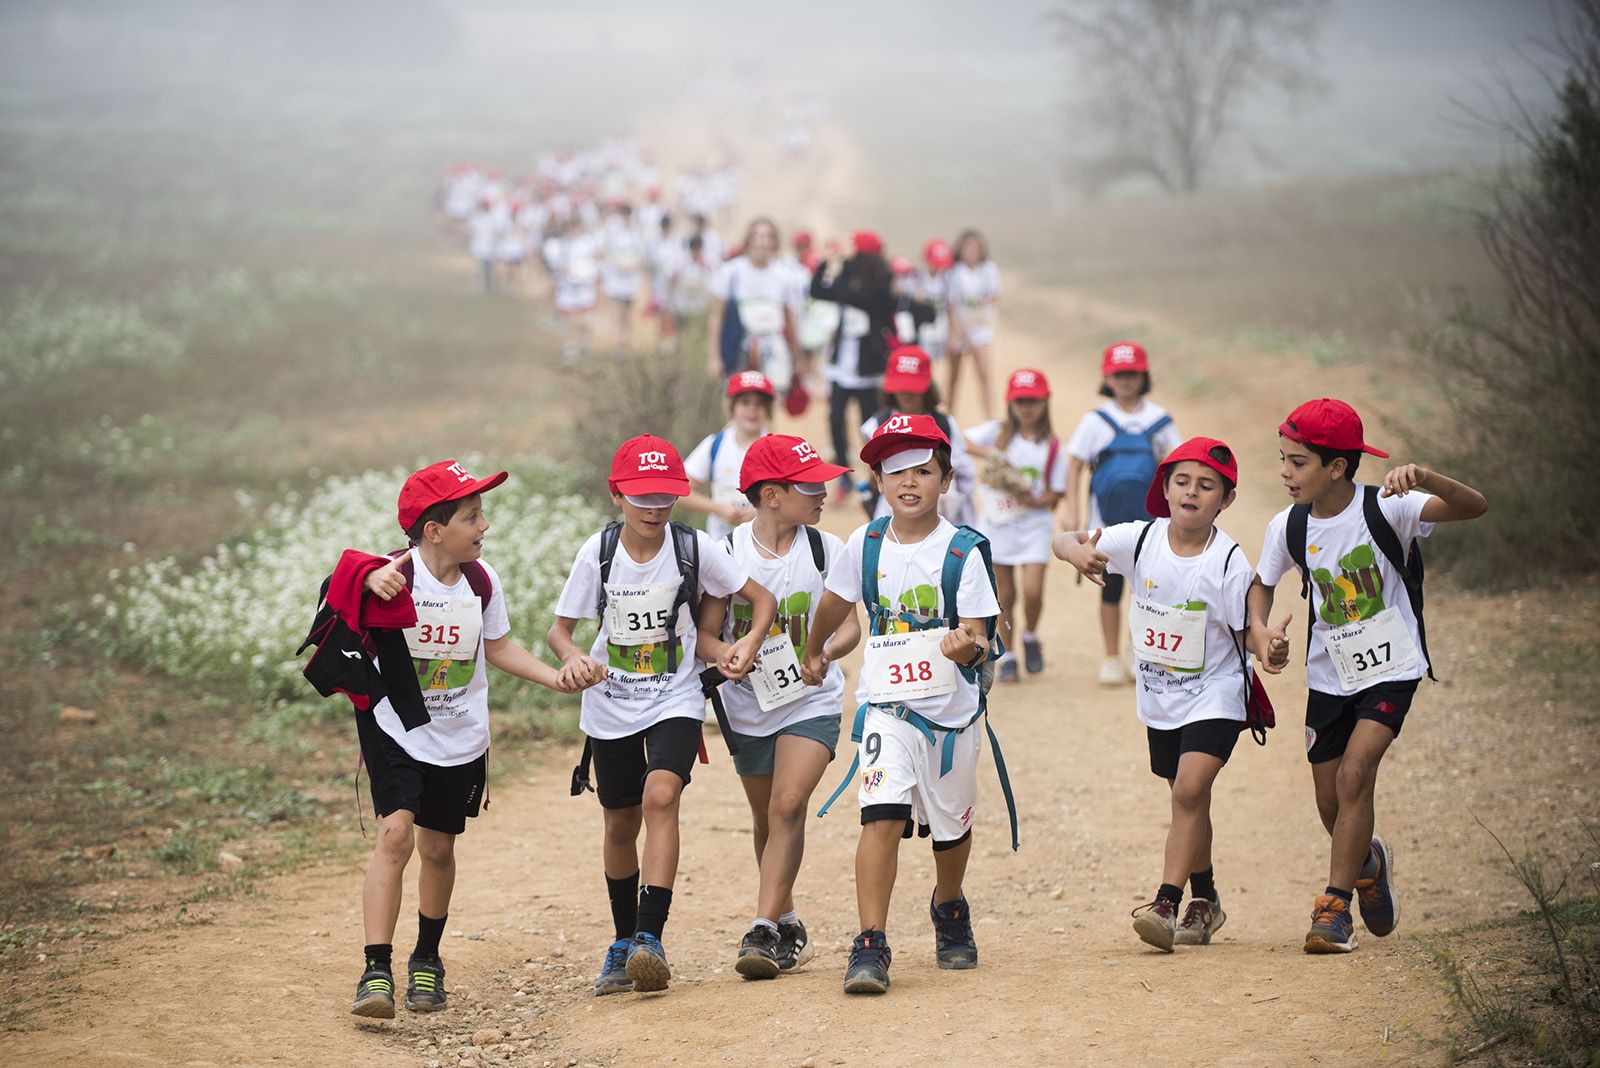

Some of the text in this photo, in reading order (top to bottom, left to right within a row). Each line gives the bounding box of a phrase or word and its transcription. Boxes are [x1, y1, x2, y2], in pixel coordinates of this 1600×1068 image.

[883, 415, 912, 434] TOT
[791, 441, 815, 457] TO
[638, 451, 667, 465] TOT
[446, 461, 466, 477] TO
[622, 589, 650, 597] Marxa"
[421, 600, 449, 608] Marxa"
[1145, 604, 1169, 617] Marxa"
[627, 609, 668, 631] 315
[418, 623, 460, 645] 315
[1144, 627, 1183, 652] 317
[1341, 626, 1366, 639] Marxa"
[882, 637, 911, 648] Marxa"
[1352, 641, 1392, 672] 317
[773, 663, 802, 689] 31
[888, 660, 933, 685] 318
[865, 732, 882, 768] 9
